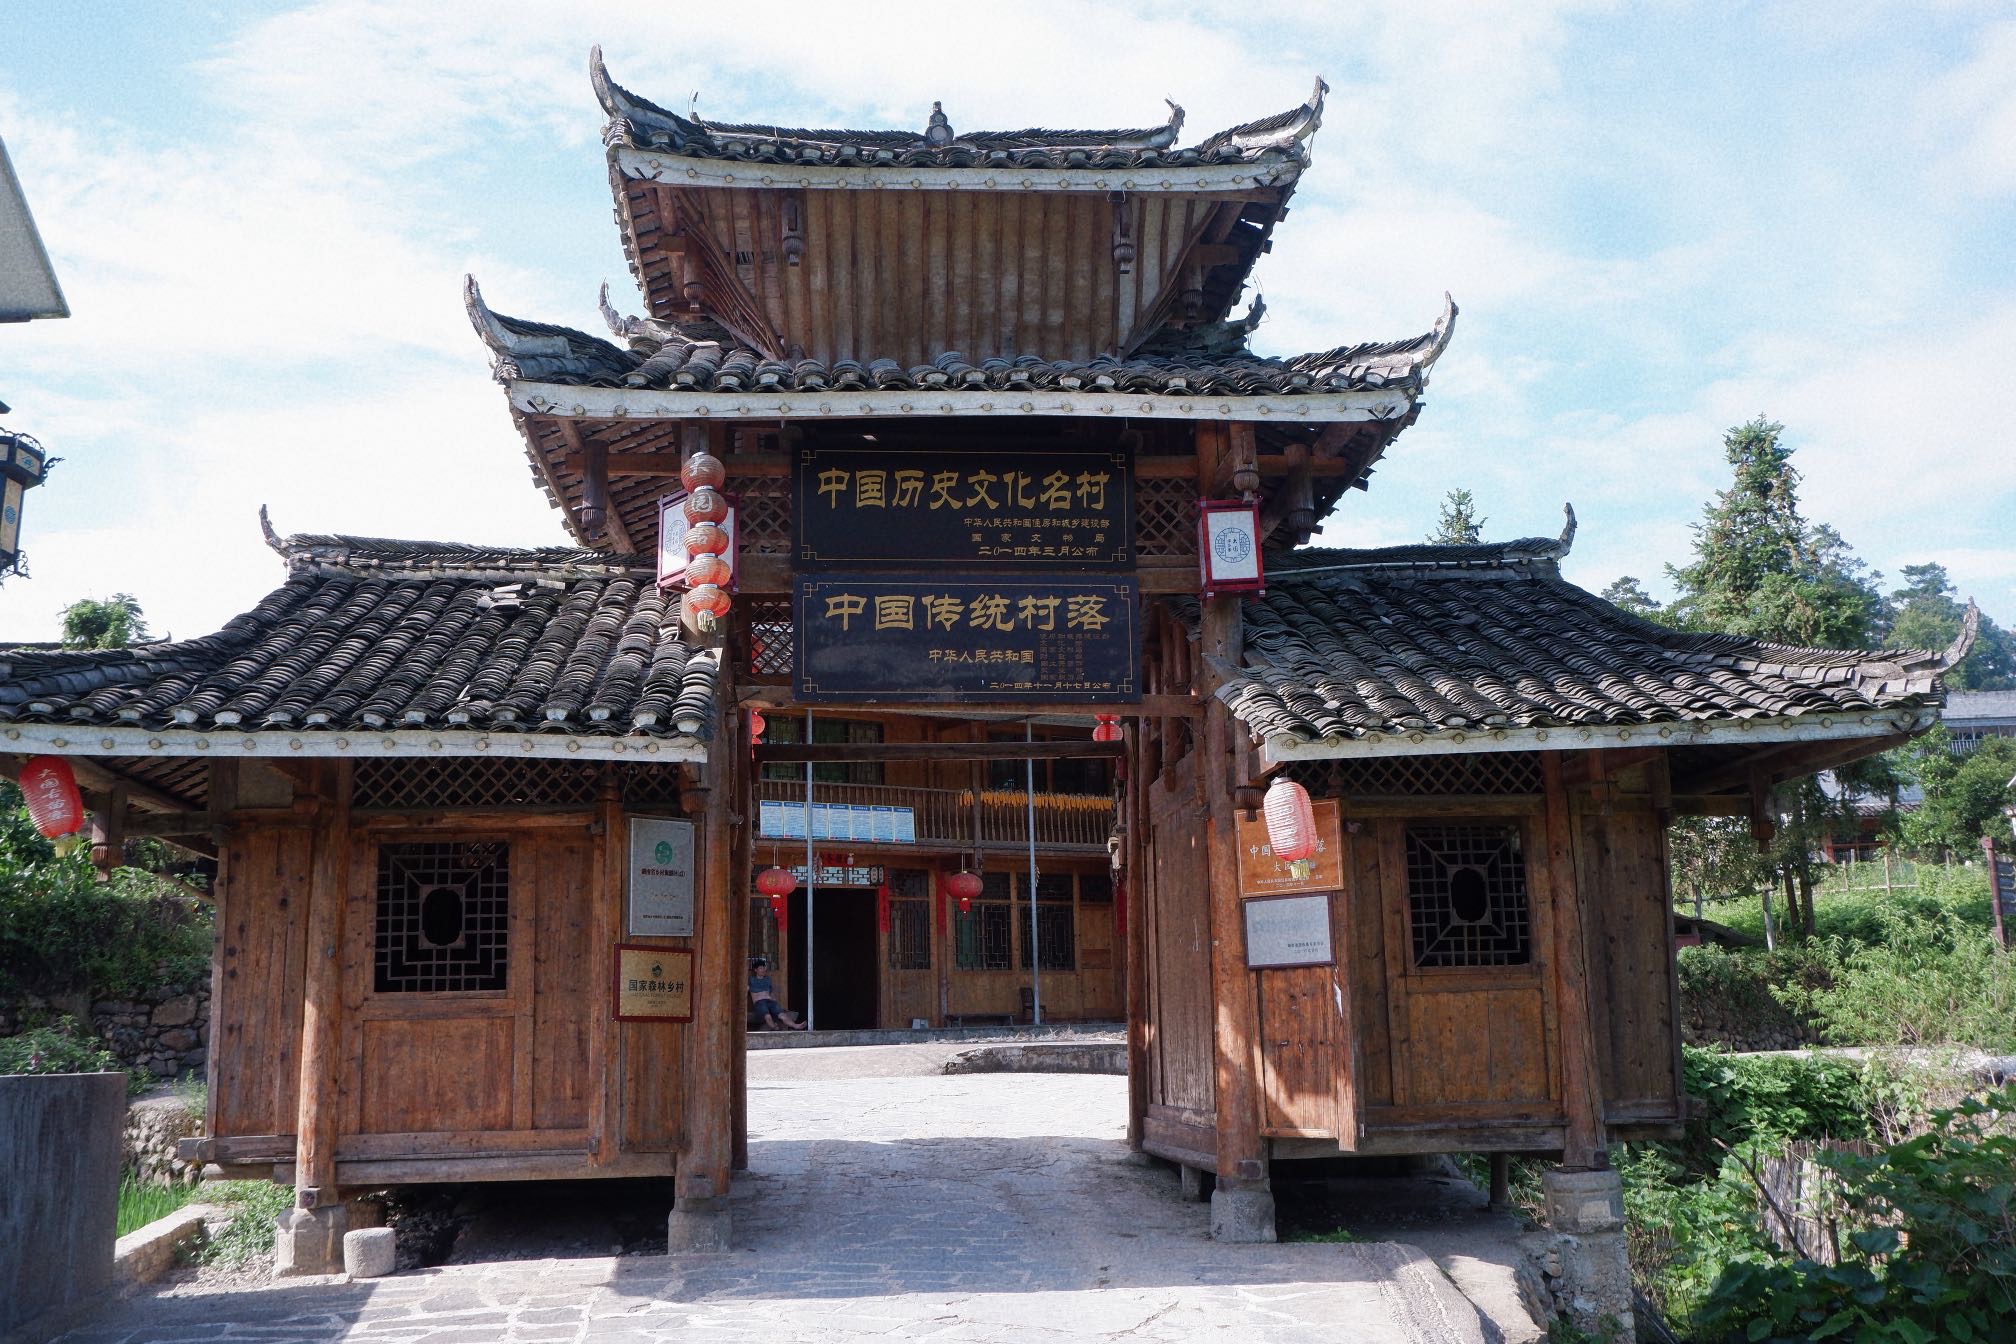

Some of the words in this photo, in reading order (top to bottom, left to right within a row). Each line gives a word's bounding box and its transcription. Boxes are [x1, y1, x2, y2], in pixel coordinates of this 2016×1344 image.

[817, 467, 1111, 511] 中国历史文化名村
[963, 518, 1111, 529] 中华人民共和国住房和城乡建设部
[824, 592, 1111, 632] 中国传统村落
[928, 648, 1034, 664] 中华人民共和国
[628, 979, 684, 993] 国家森林乡村
